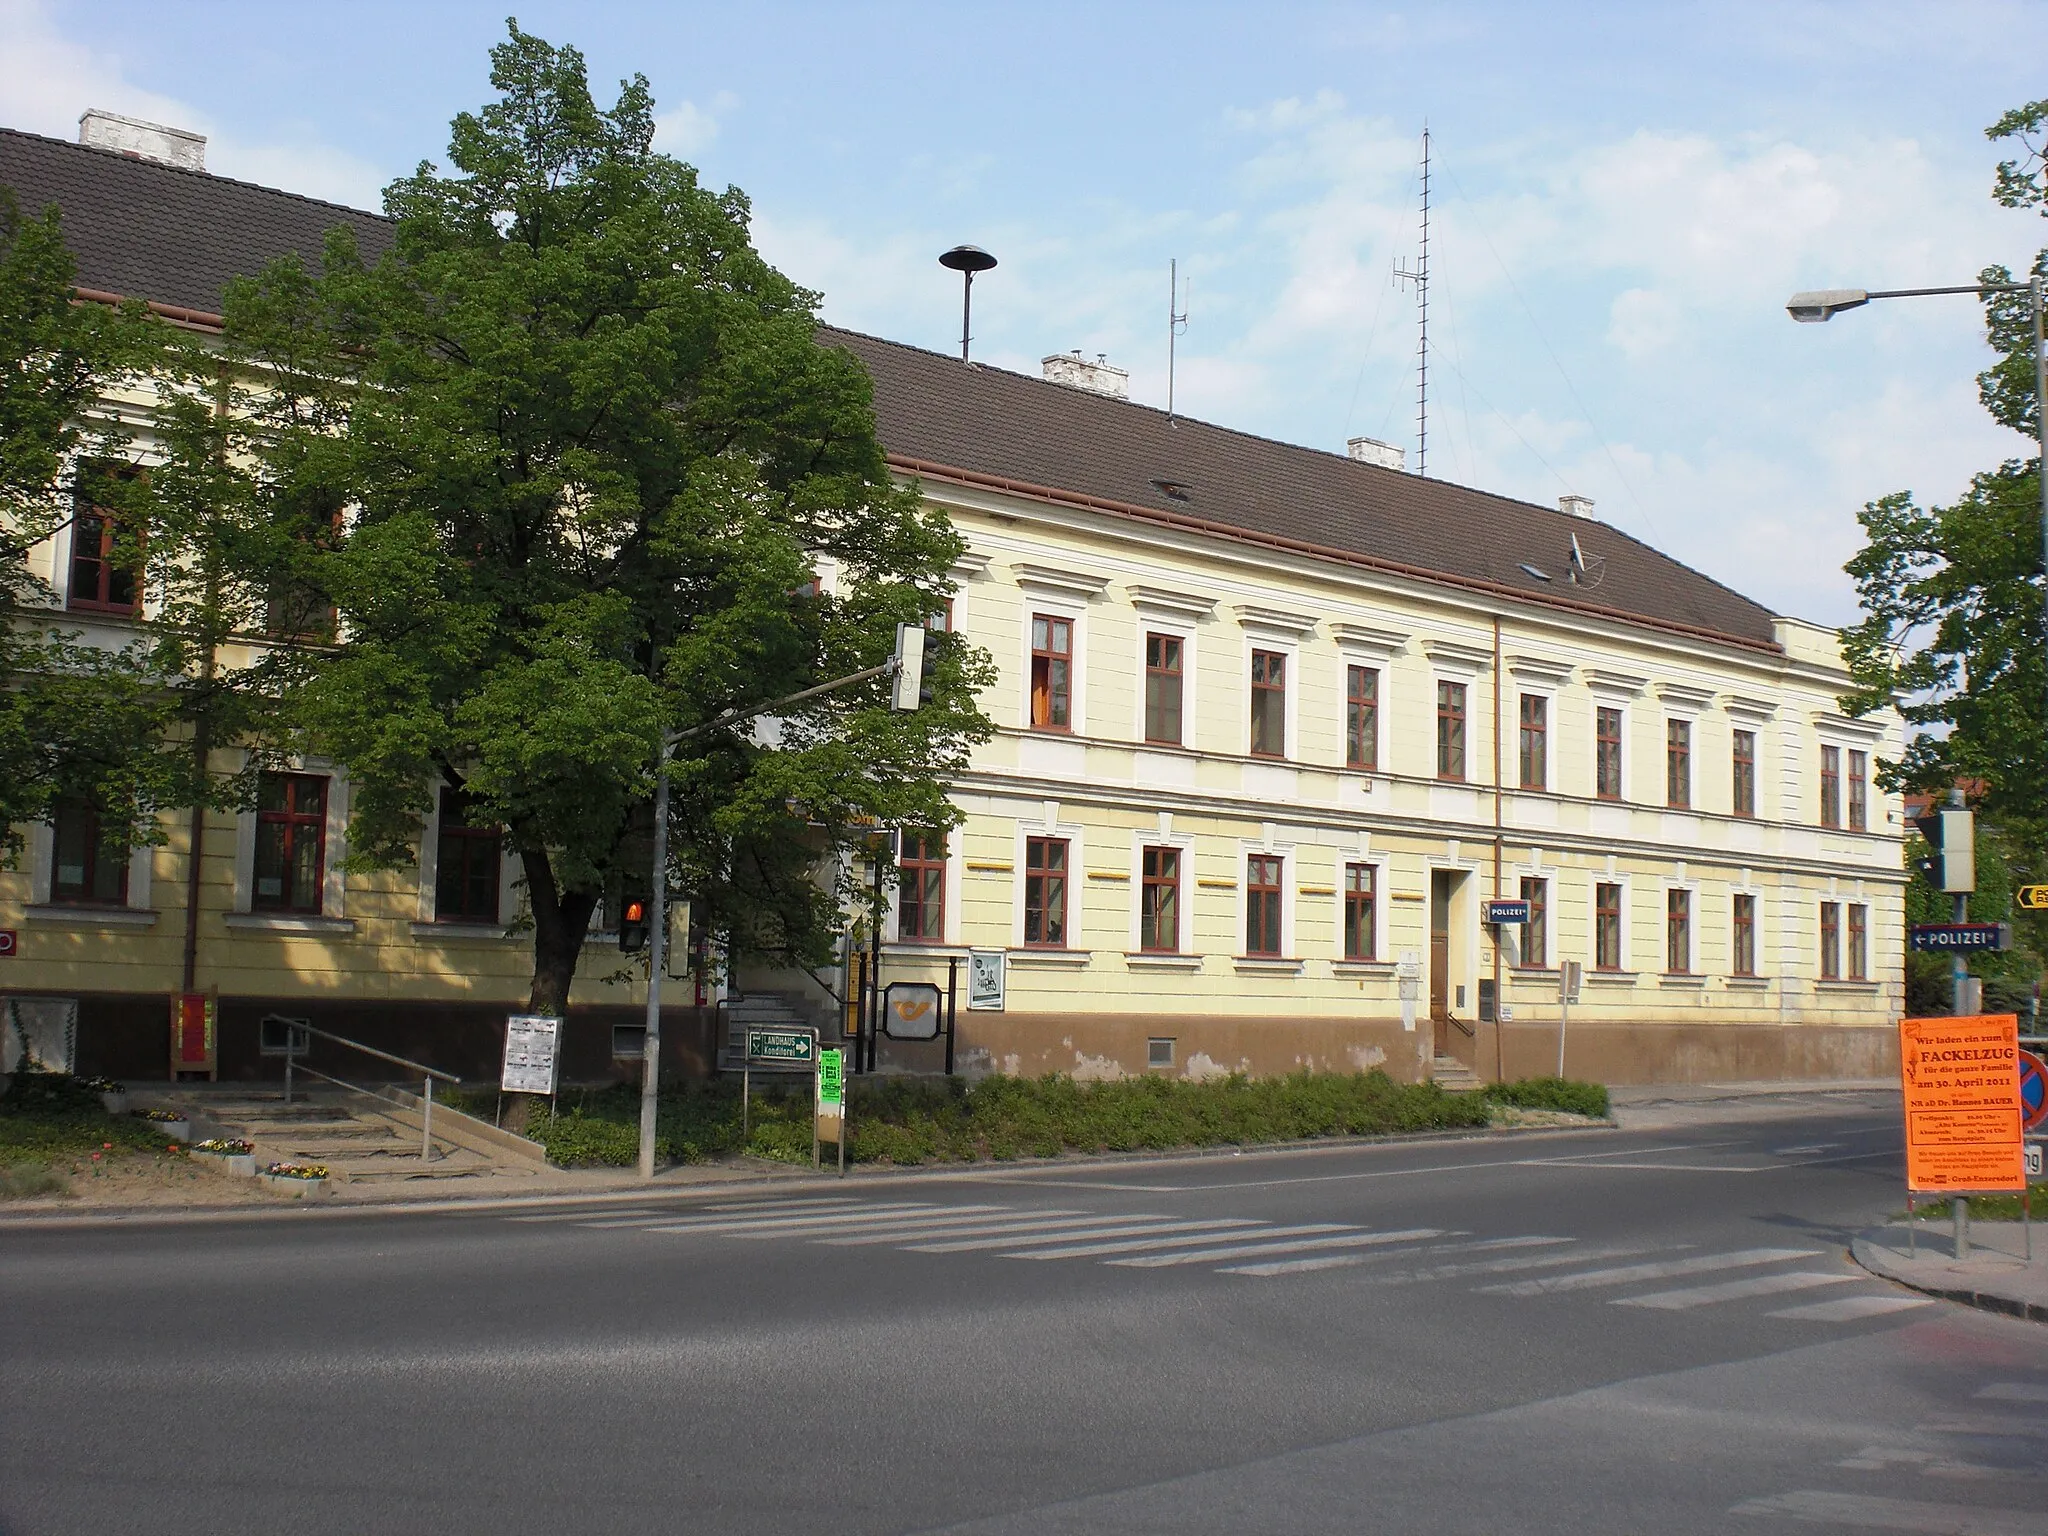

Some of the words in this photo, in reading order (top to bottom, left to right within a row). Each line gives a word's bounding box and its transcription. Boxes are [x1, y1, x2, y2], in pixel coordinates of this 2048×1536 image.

[1492, 908, 1522, 916] POLIZEI
[1929, 932, 1986, 945] POLIZEI
[763, 1035, 796, 1047] LANDHAUS
[1936, 1036, 1962, 1044] laden
[1964, 1035, 1979, 1043] ein
[1921, 1048, 2014, 1062] FACKELZUG
[1955, 1066, 1979, 1074] ganze
[1981, 1063, 2013, 1071] Familie
[1936, 1080, 1952, 1088] 30.
[1955, 1078, 1983, 1088] April
[1986, 1078, 2011, 1086] 2011
